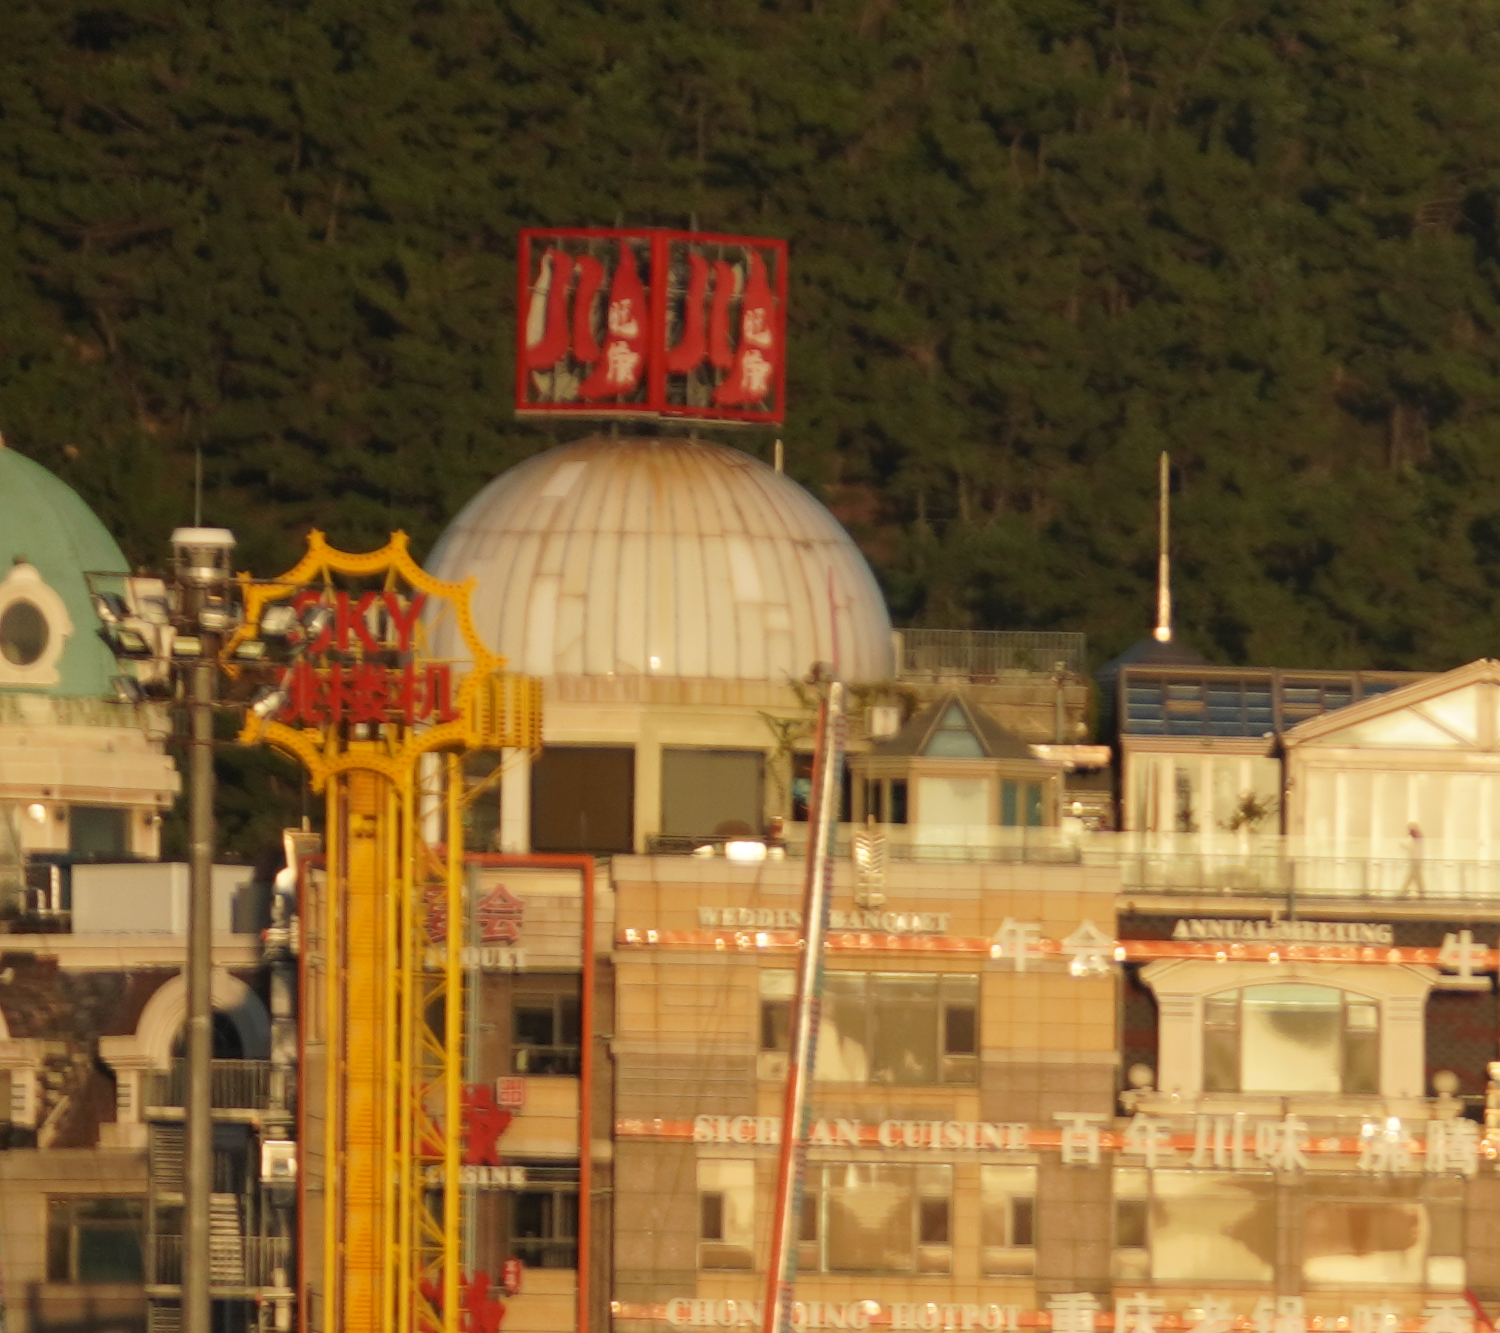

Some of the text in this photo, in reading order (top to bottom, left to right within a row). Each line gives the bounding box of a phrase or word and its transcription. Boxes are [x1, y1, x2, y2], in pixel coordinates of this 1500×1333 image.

[697, 907, 804, 928] WEDDIN
[1171, 918, 1270, 941] ANNUAL
[993, 917, 1116, 976] 年会
[694, 1114, 1030, 1150] SICHAN CUISINE
[665, 1298, 1022, 1333] CHONQING HOTPOT
